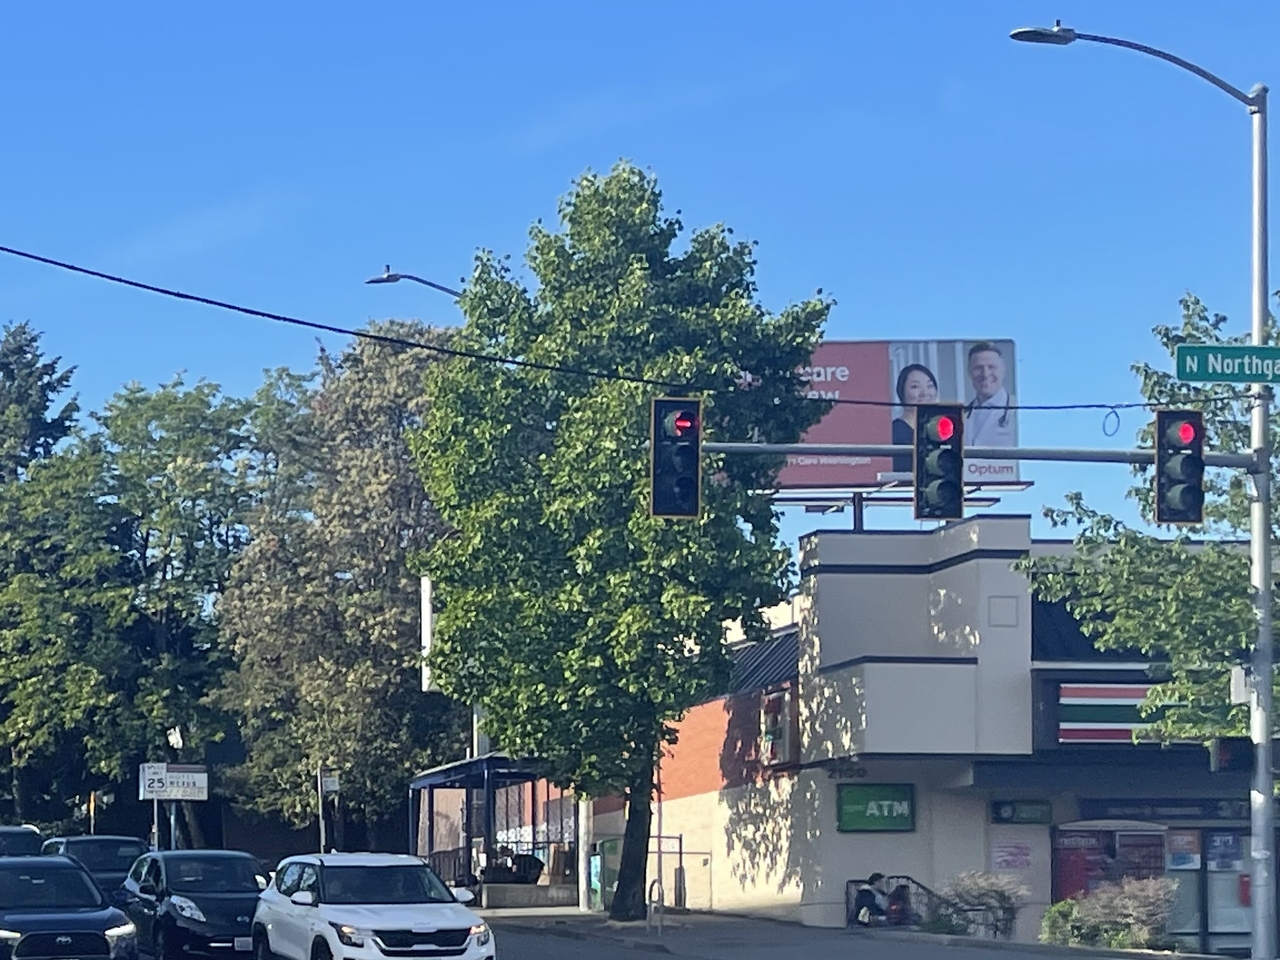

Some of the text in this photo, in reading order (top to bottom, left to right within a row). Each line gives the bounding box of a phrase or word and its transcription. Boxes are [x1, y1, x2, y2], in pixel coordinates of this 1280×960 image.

[1186, 355, 1198, 373] N
[968, 463, 1013, 475] Optum
[147, 778, 165, 789] 25
[865, 800, 909, 817] ATM
